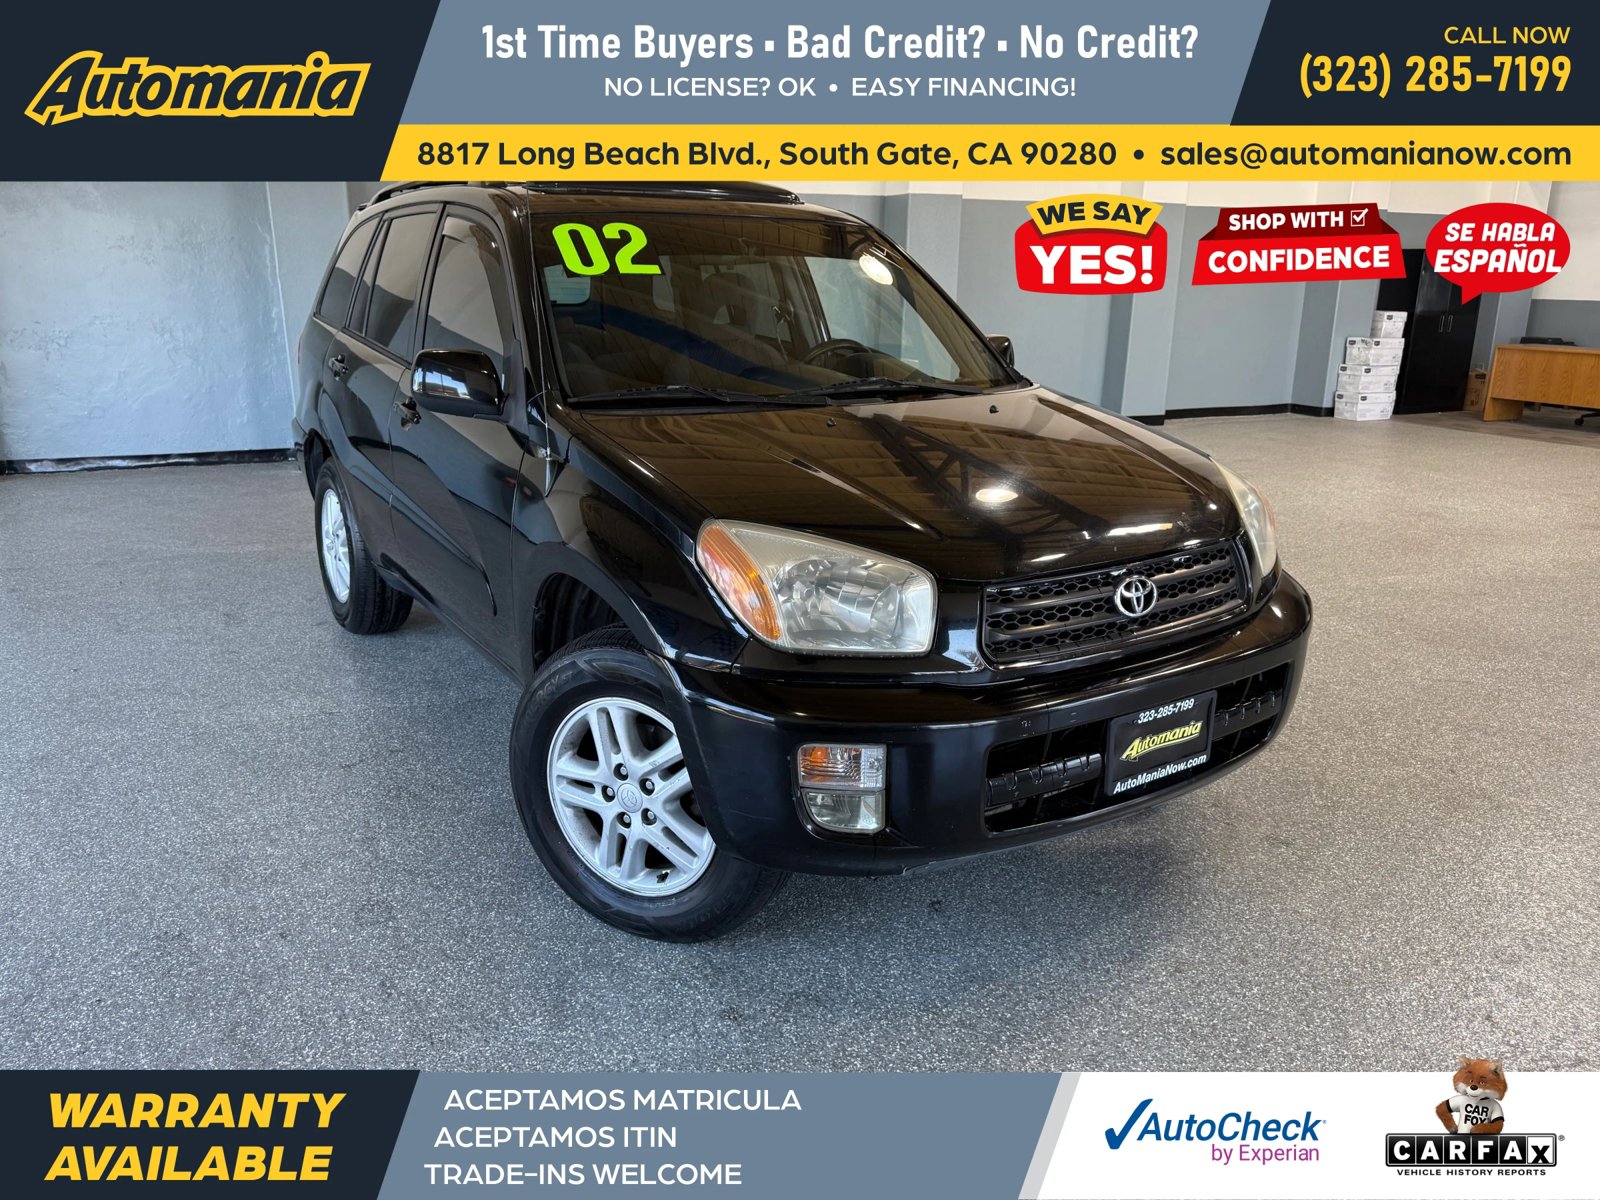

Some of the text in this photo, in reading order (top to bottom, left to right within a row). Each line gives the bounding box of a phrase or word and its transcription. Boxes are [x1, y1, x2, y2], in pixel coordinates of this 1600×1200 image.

[552, 222, 662, 275] 02
[1137, 698, 1195, 724] 323-285-7199
[1120, 720, 1203, 761] Automania
[1113, 754, 1207, 795] AutoManiaNow.com
